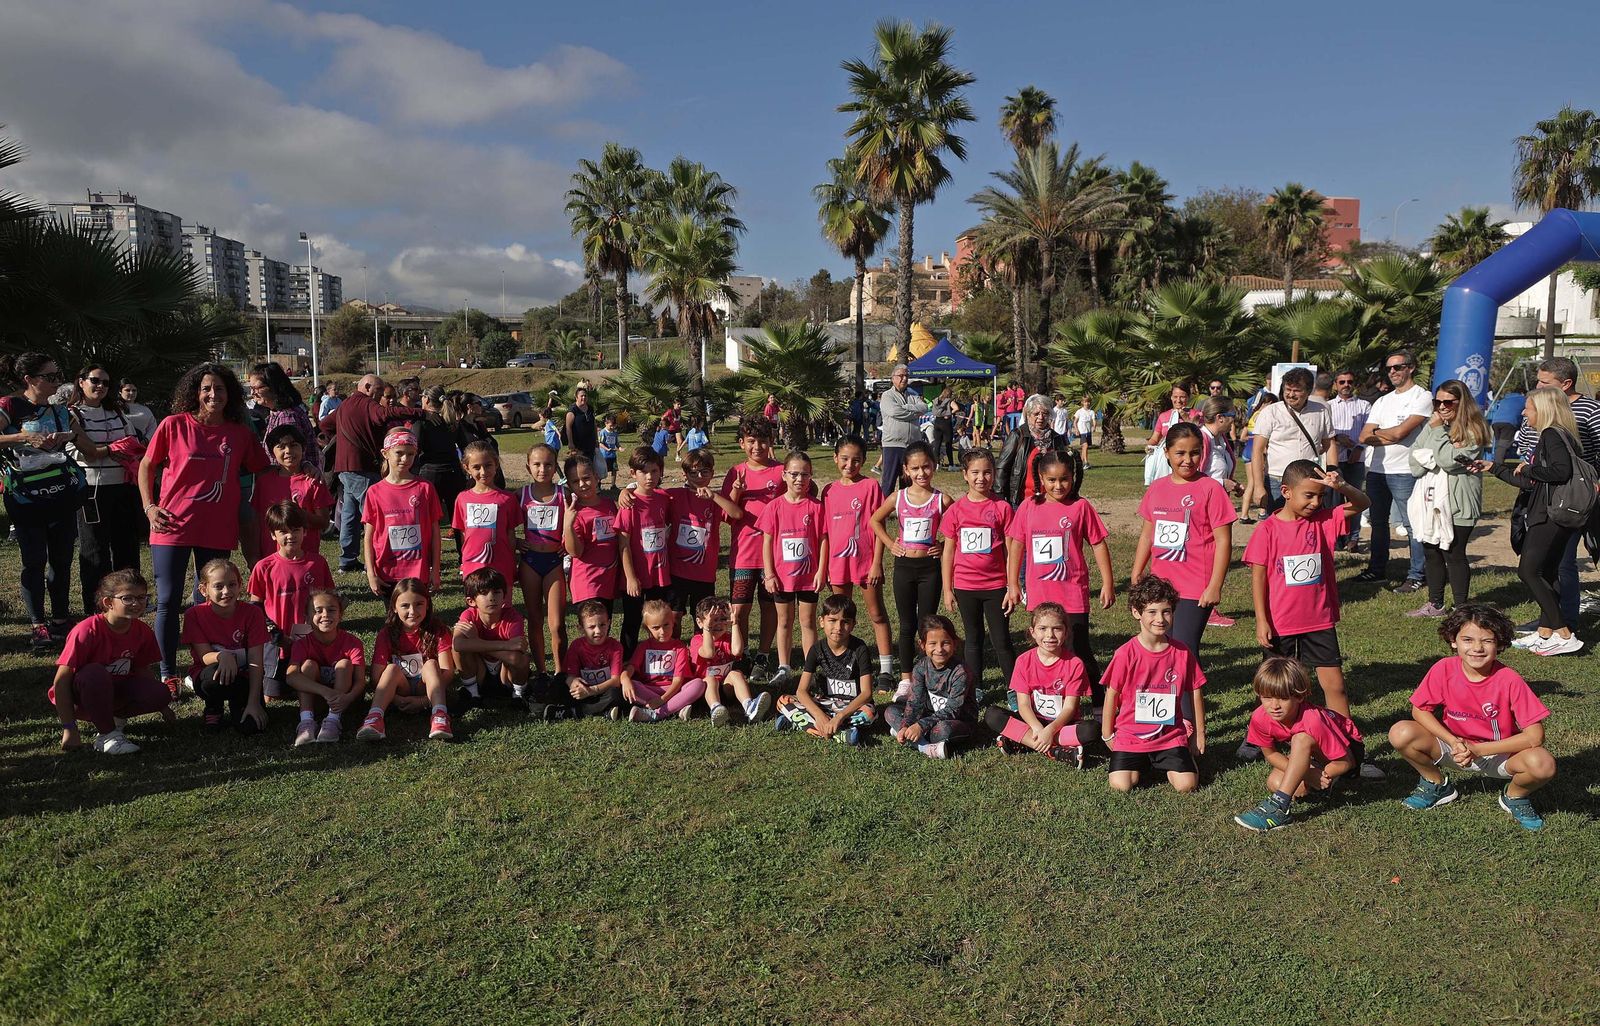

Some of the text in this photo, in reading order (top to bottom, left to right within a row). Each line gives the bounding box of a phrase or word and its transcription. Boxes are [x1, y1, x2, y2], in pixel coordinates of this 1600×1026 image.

[473, 507, 491, 524] 82
[537, 509, 553, 525] 79
[399, 526, 418, 546] 78
[687, 529, 699, 545] 8
[912, 520, 931, 538] 77
[1158, 524, 1179, 543] 83
[649, 530, 664, 547] 75
[966, 532, 983, 550] 81
[788, 542, 805, 557] 90
[1039, 539, 1053, 559] 4
[1291, 558, 1319, 582] 62
[650, 654, 673, 672] 118
[830, 680, 852, 696] 189
[1037, 698, 1056, 716] 73
[1147, 697, 1167, 718] 16
